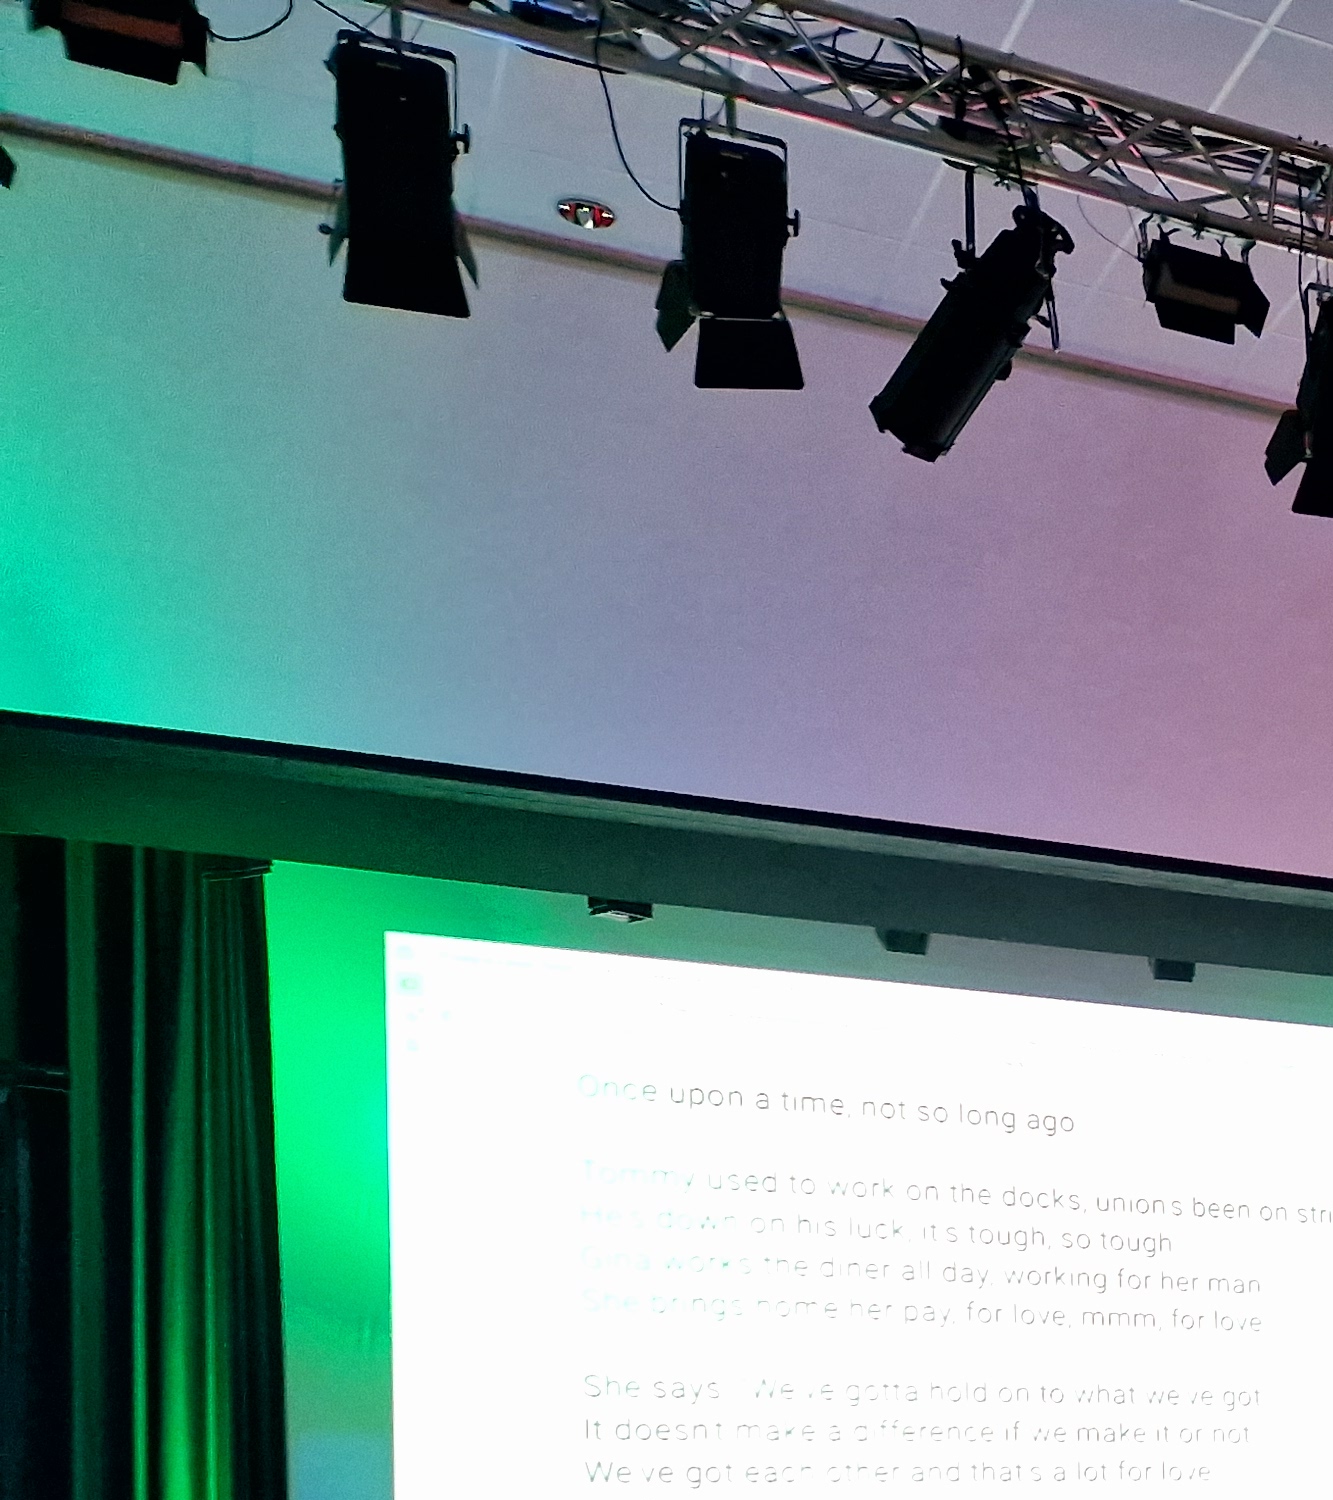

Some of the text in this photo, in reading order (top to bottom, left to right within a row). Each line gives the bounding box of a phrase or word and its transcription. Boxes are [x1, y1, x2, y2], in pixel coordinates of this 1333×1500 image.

[577, 1073, 657, 1102] Once
[670, 1087, 743, 1110] upon
[755, 1092, 770, 1110] a
[862, 1100, 906, 1120] not
[917, 1105, 949, 1124] so
[959, 1102, 1016, 1135] long
[1026, 1113, 1075, 1137] ago
[708, 1172, 777, 1193] used
[788, 1174, 816, 1195] to
[827, 1177, 894, 1198] work
[906, 1184, 939, 1201] on
[949, 1183, 992, 1206] the
[1002, 1185, 1087, 1214] docks,
[1192, 1196, 1250, 1220] been
[1259, 1205, 1288, 1222] on
[578, 1203, 646, 1231] Hes
[750, 1216, 785, 1234] on
[797, 1214, 837, 1237] his
[923, 1223, 959, 1243] its
[968, 1225, 1052, 1252] tough,
[1061, 1232, 1091, 1250] so
[1099, 1231, 1172, 1259] tough
[763, 1256, 809, 1277] the
[819, 1257, 891, 1280] diner
[901, 1260, 930, 1282] all
[1004, 1265, 1107, 1295] working
[1117, 1267, 1152, 1290] for
[1161, 1270, 1199, 1292] her
[1208, 1277, 1261, 1294] man
[849, 1301, 893, 1321] her
[966, 1300, 1003, 1324] for
[1082, 1311, 1162, 1332] mmm,
[1171, 1307, 1205, 1331] for
[1214, 1309, 1262, 1333] love
[584, 1374, 641, 1398] She
[653, 1380, 720, 1405] says
[930, 1381, 987, 1403] hold
[998, 1386, 1030, 1403] on
[1039, 1385, 1065, 1404] to
[1074, 1383, 1135, 1405] what
[1146, 1389, 1214, 1406] weve
[1222, 1389, 1260, 1412] got
[585, 1418, 602, 1441] It
[615, 1418, 723, 1441] doesnt
[828, 1424, 841, 1442] a
[1005, 1420, 1021, 1441] if
[1033, 1426, 1067, 1443] we
[1076, 1422, 1146, 1444] make
[1156, 1425, 1169, 1443] it
[1179, 1427, 1203, 1444] or
[1213, 1426, 1249, 1444] not
[584, 1460, 674, 1484] Weve
[685, 1463, 733, 1490] got
[911, 1462, 960, 1483] and
[970, 1461, 1042, 1483] thats
[1053, 1466, 1066, 1482] a
[1077, 1461, 1107, 1482] lot
[1118, 1459, 1152, 1482] for
